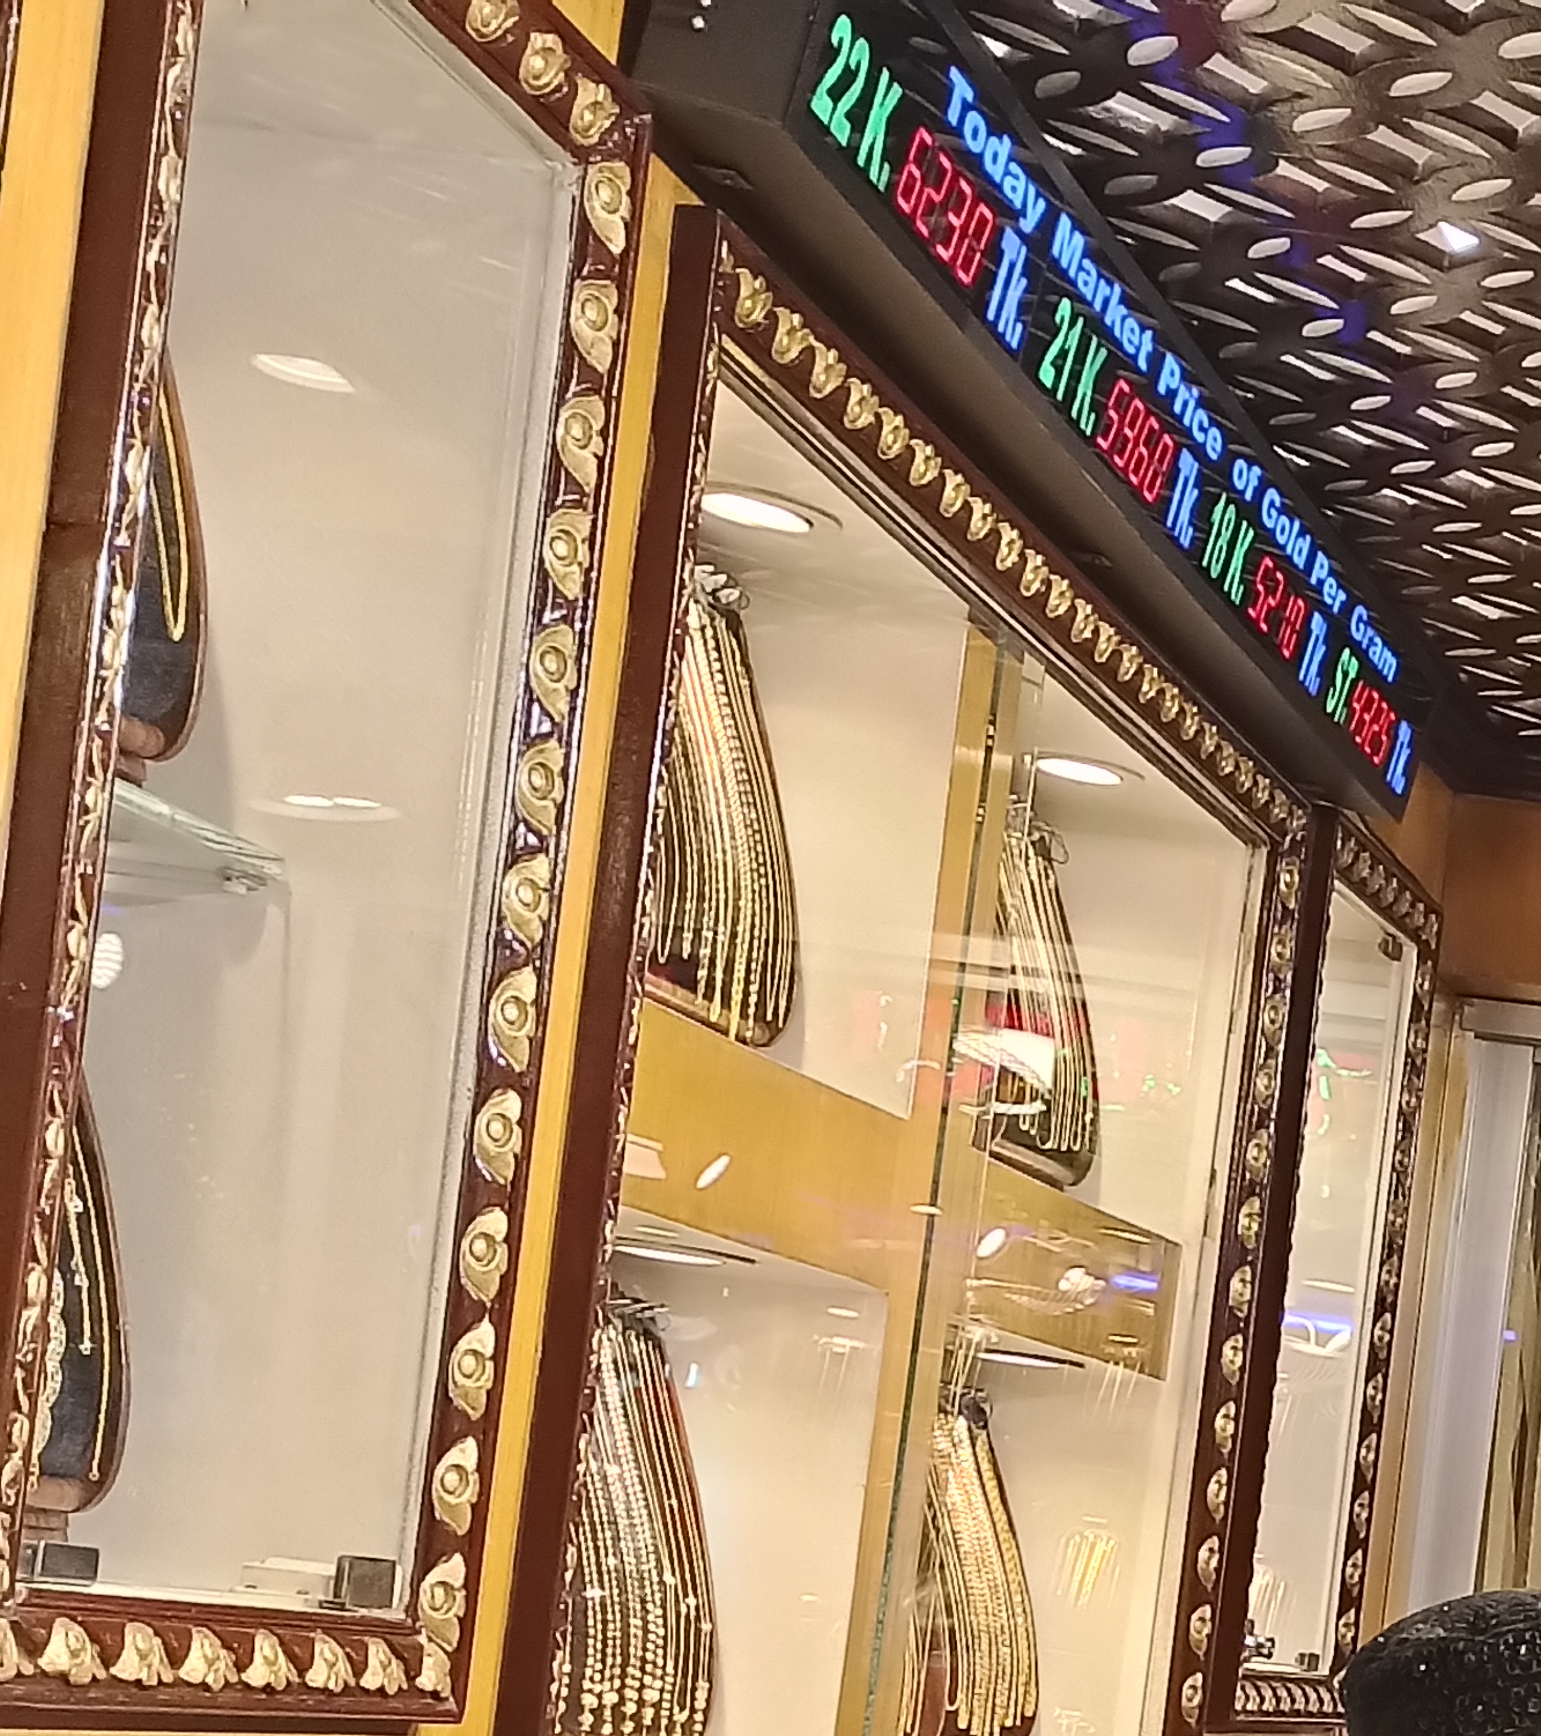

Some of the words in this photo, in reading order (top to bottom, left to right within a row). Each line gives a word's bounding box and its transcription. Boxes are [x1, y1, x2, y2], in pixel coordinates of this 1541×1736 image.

[896, 126, 994, 286] 6230
[1096, 378, 1174, 503] 5960
[947, 65, 1047, 234] Today
[1052, 212, 1154, 373] Market
[1157, 351, 1223, 461] Price
[1232, 458, 1262, 502] of
[1261, 487, 1312, 570] Gold
[1310, 550, 1347, 615] Per
[1350, 604, 1398, 683] Gram
